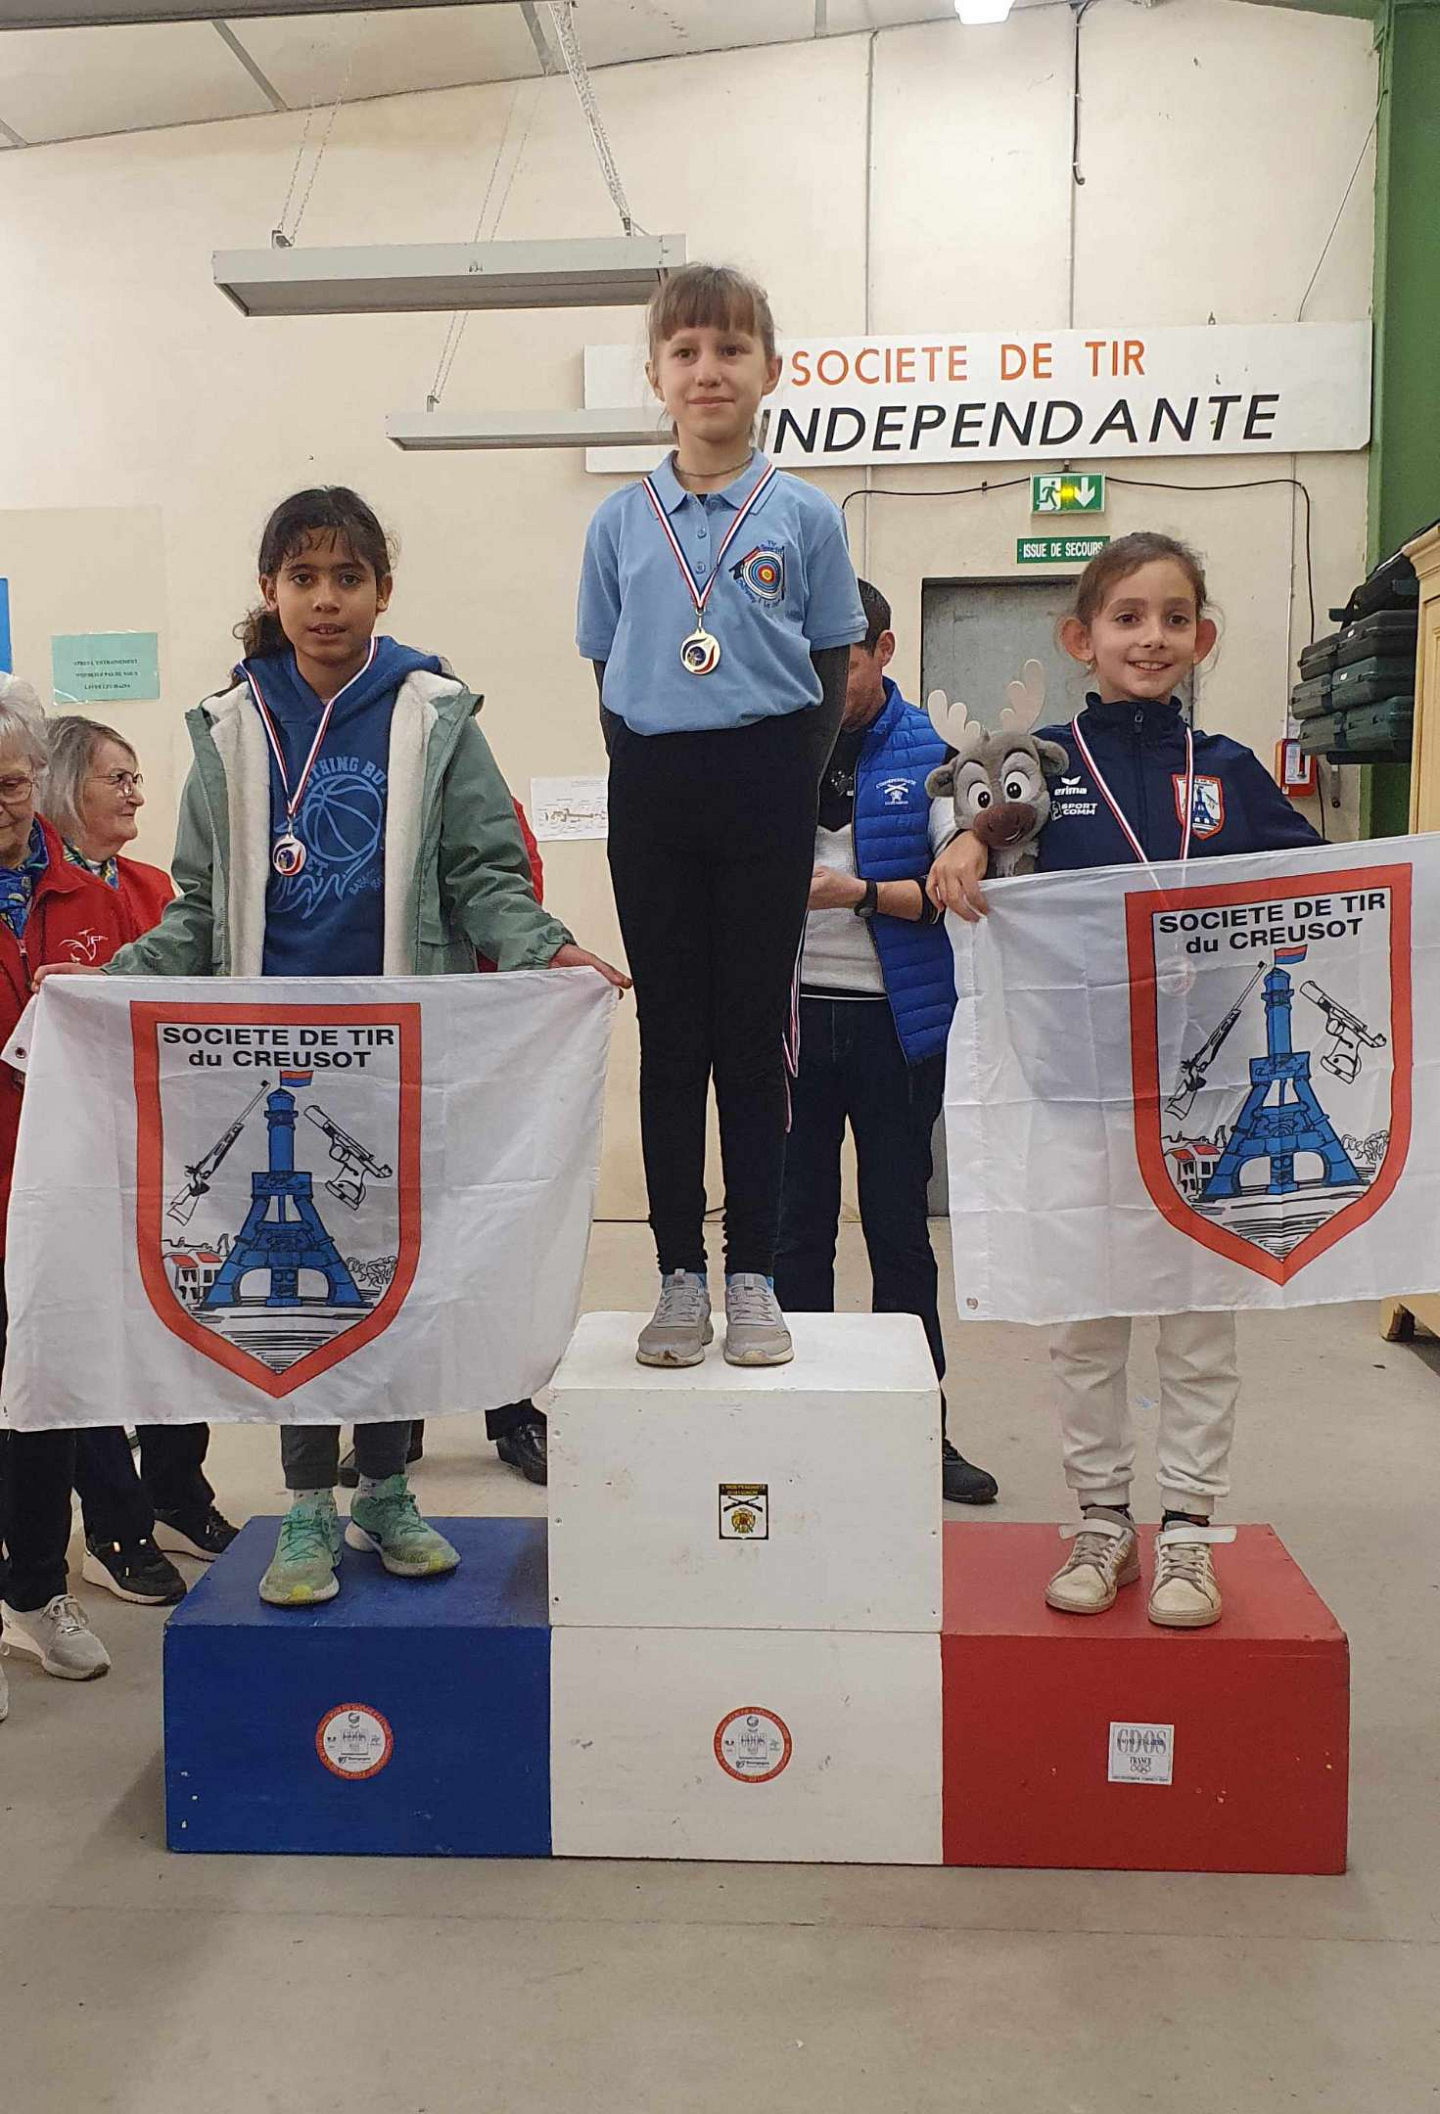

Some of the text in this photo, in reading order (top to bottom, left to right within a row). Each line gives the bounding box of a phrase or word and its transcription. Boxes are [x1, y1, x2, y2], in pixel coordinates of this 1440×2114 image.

[791, 339, 1147, 387] SOCIETE DE TIR
[1023, 543, 1047, 558] ISSUE
[1050, 542, 1062, 557] DE
[361, 761, 387, 795] BU
[1054, 785, 1088, 796] erima
[1159, 892, 1387, 933] SOCIETE DE TIR
[1185, 918, 1364, 955] du CREUSOT
[163, 1027, 395, 1046] SOCIETE DE TIR
[188, 1050, 372, 1068] du CREUSOT
